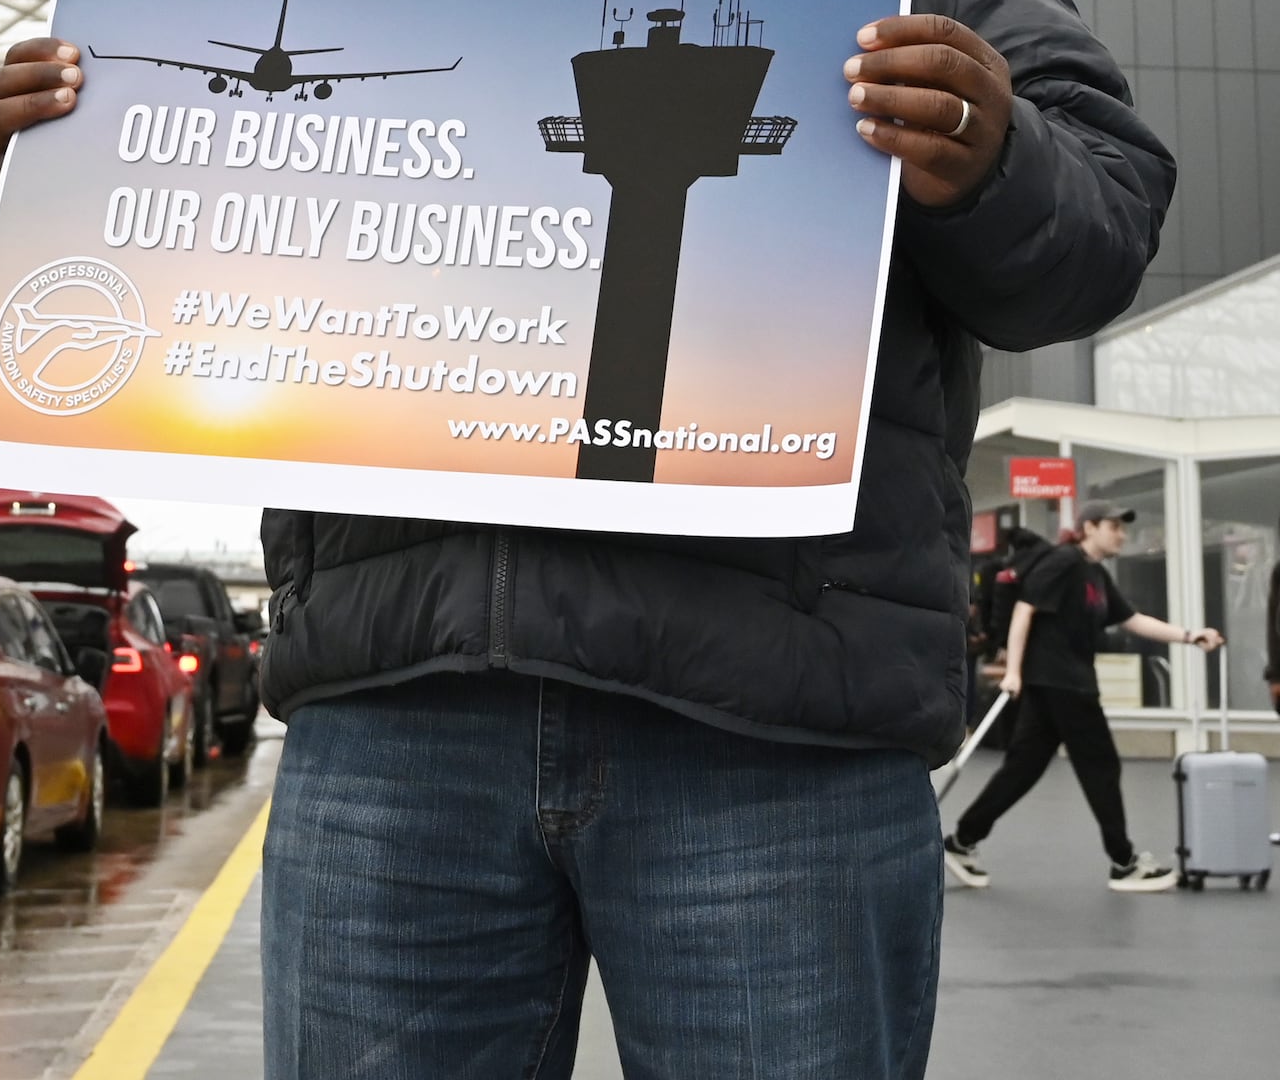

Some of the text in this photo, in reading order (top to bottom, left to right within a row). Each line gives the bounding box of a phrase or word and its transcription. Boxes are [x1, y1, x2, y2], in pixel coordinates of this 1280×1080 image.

[118, 104, 475, 180] OUR BUSINESS.
[103, 186, 602, 270] OUR ONLY BUSINESS.
[29, 265, 128, 301] PROFESSIONAL
[171, 290, 568, 345] #WeWantToWork
[1, 320, 133, 408] AVIATION SAFETY SPECIALISTS
[162, 341, 578, 398] #EndTheShutdown
[447, 416, 838, 459] www.PASSnational.org
